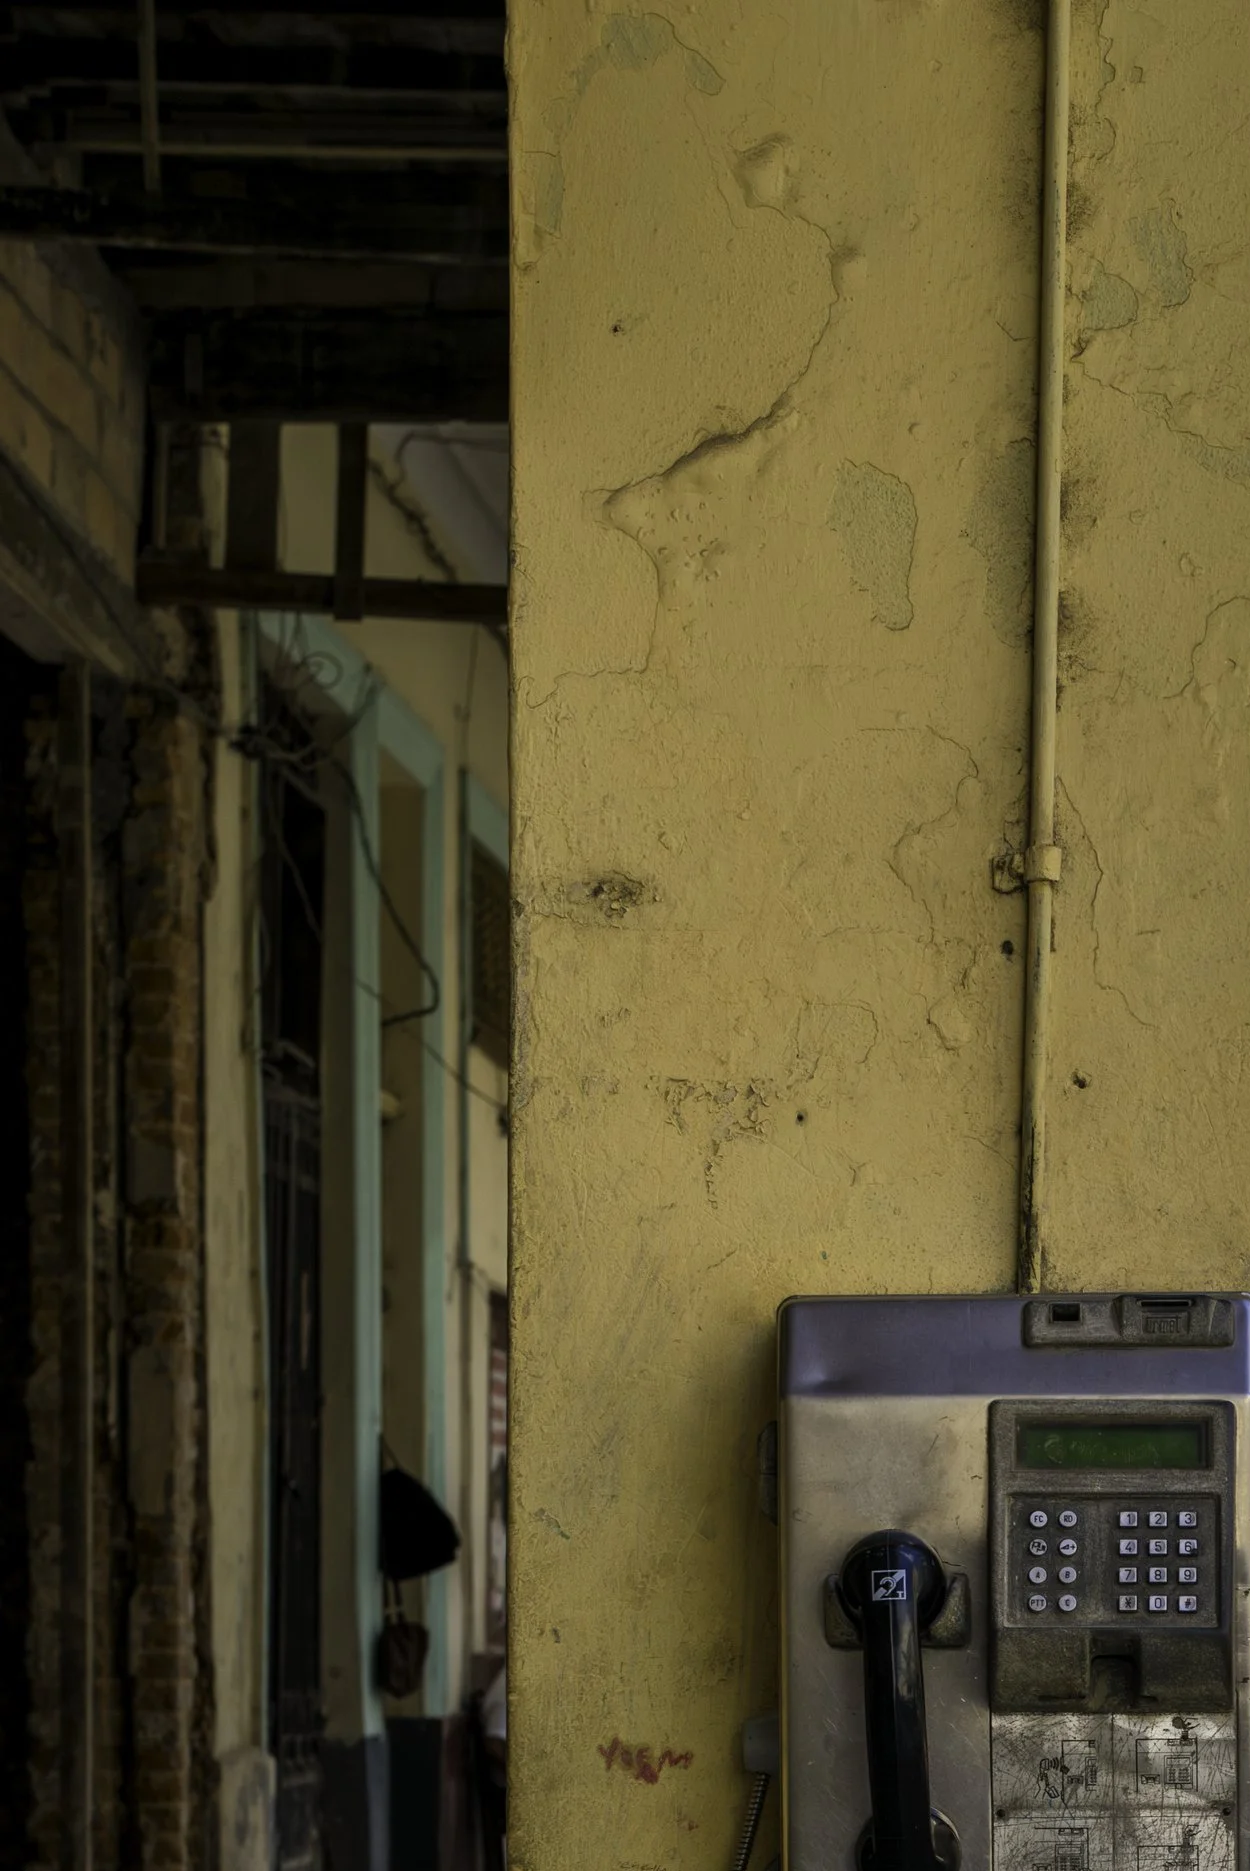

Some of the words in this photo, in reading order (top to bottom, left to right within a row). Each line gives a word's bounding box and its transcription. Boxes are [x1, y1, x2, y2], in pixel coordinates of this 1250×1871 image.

[1034, 1515, 1044, 1523] FC
[1063, 1515, 1073, 1523] RD
[1154, 1513, 1162, 1524] 2
[1184, 1513, 1192, 1524] 3
[1125, 1541, 1132, 1552] 4
[1154, 1541, 1162, 1552] 5
[1184, 1541, 1192, 1552] 6
[1124, 1569, 1132, 1580] 7
[1154, 1569, 1162, 1580] 8
[1184, 1569, 1192, 1580] 9
[896, 1590, 904, 1598] T
[1030, 1599, 1045, 1607] PTT
[1154, 1597, 1162, 1609] 0
[1184, 1598, 1192, 1609] #
